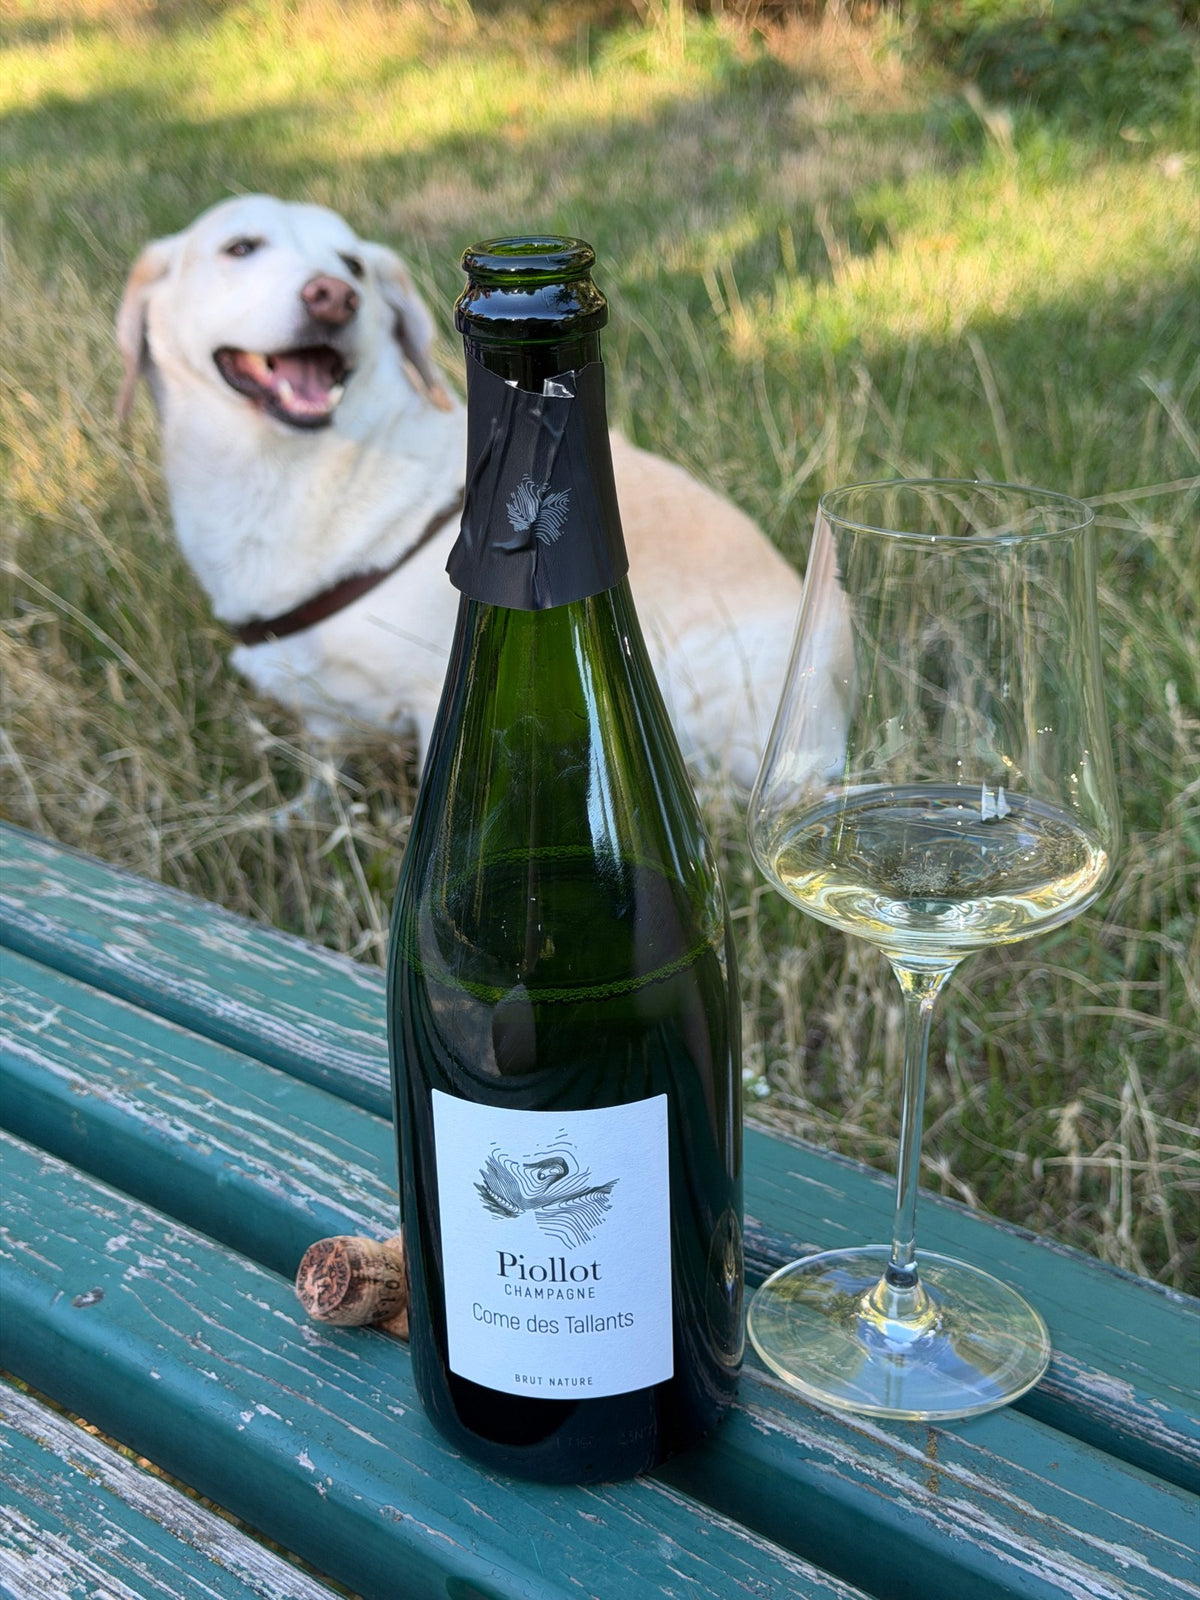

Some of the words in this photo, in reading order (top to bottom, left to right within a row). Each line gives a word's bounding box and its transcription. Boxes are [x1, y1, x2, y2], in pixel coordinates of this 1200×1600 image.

[495, 1250, 602, 1283] Piollot
[504, 1283, 596, 1301] CHAMPAGNE
[526, 1314, 560, 1335] des
[564, 1311, 635, 1334] Tallants
[514, 1373, 543, 1386] BRUT
[548, 1376, 593, 1387] NATURE
